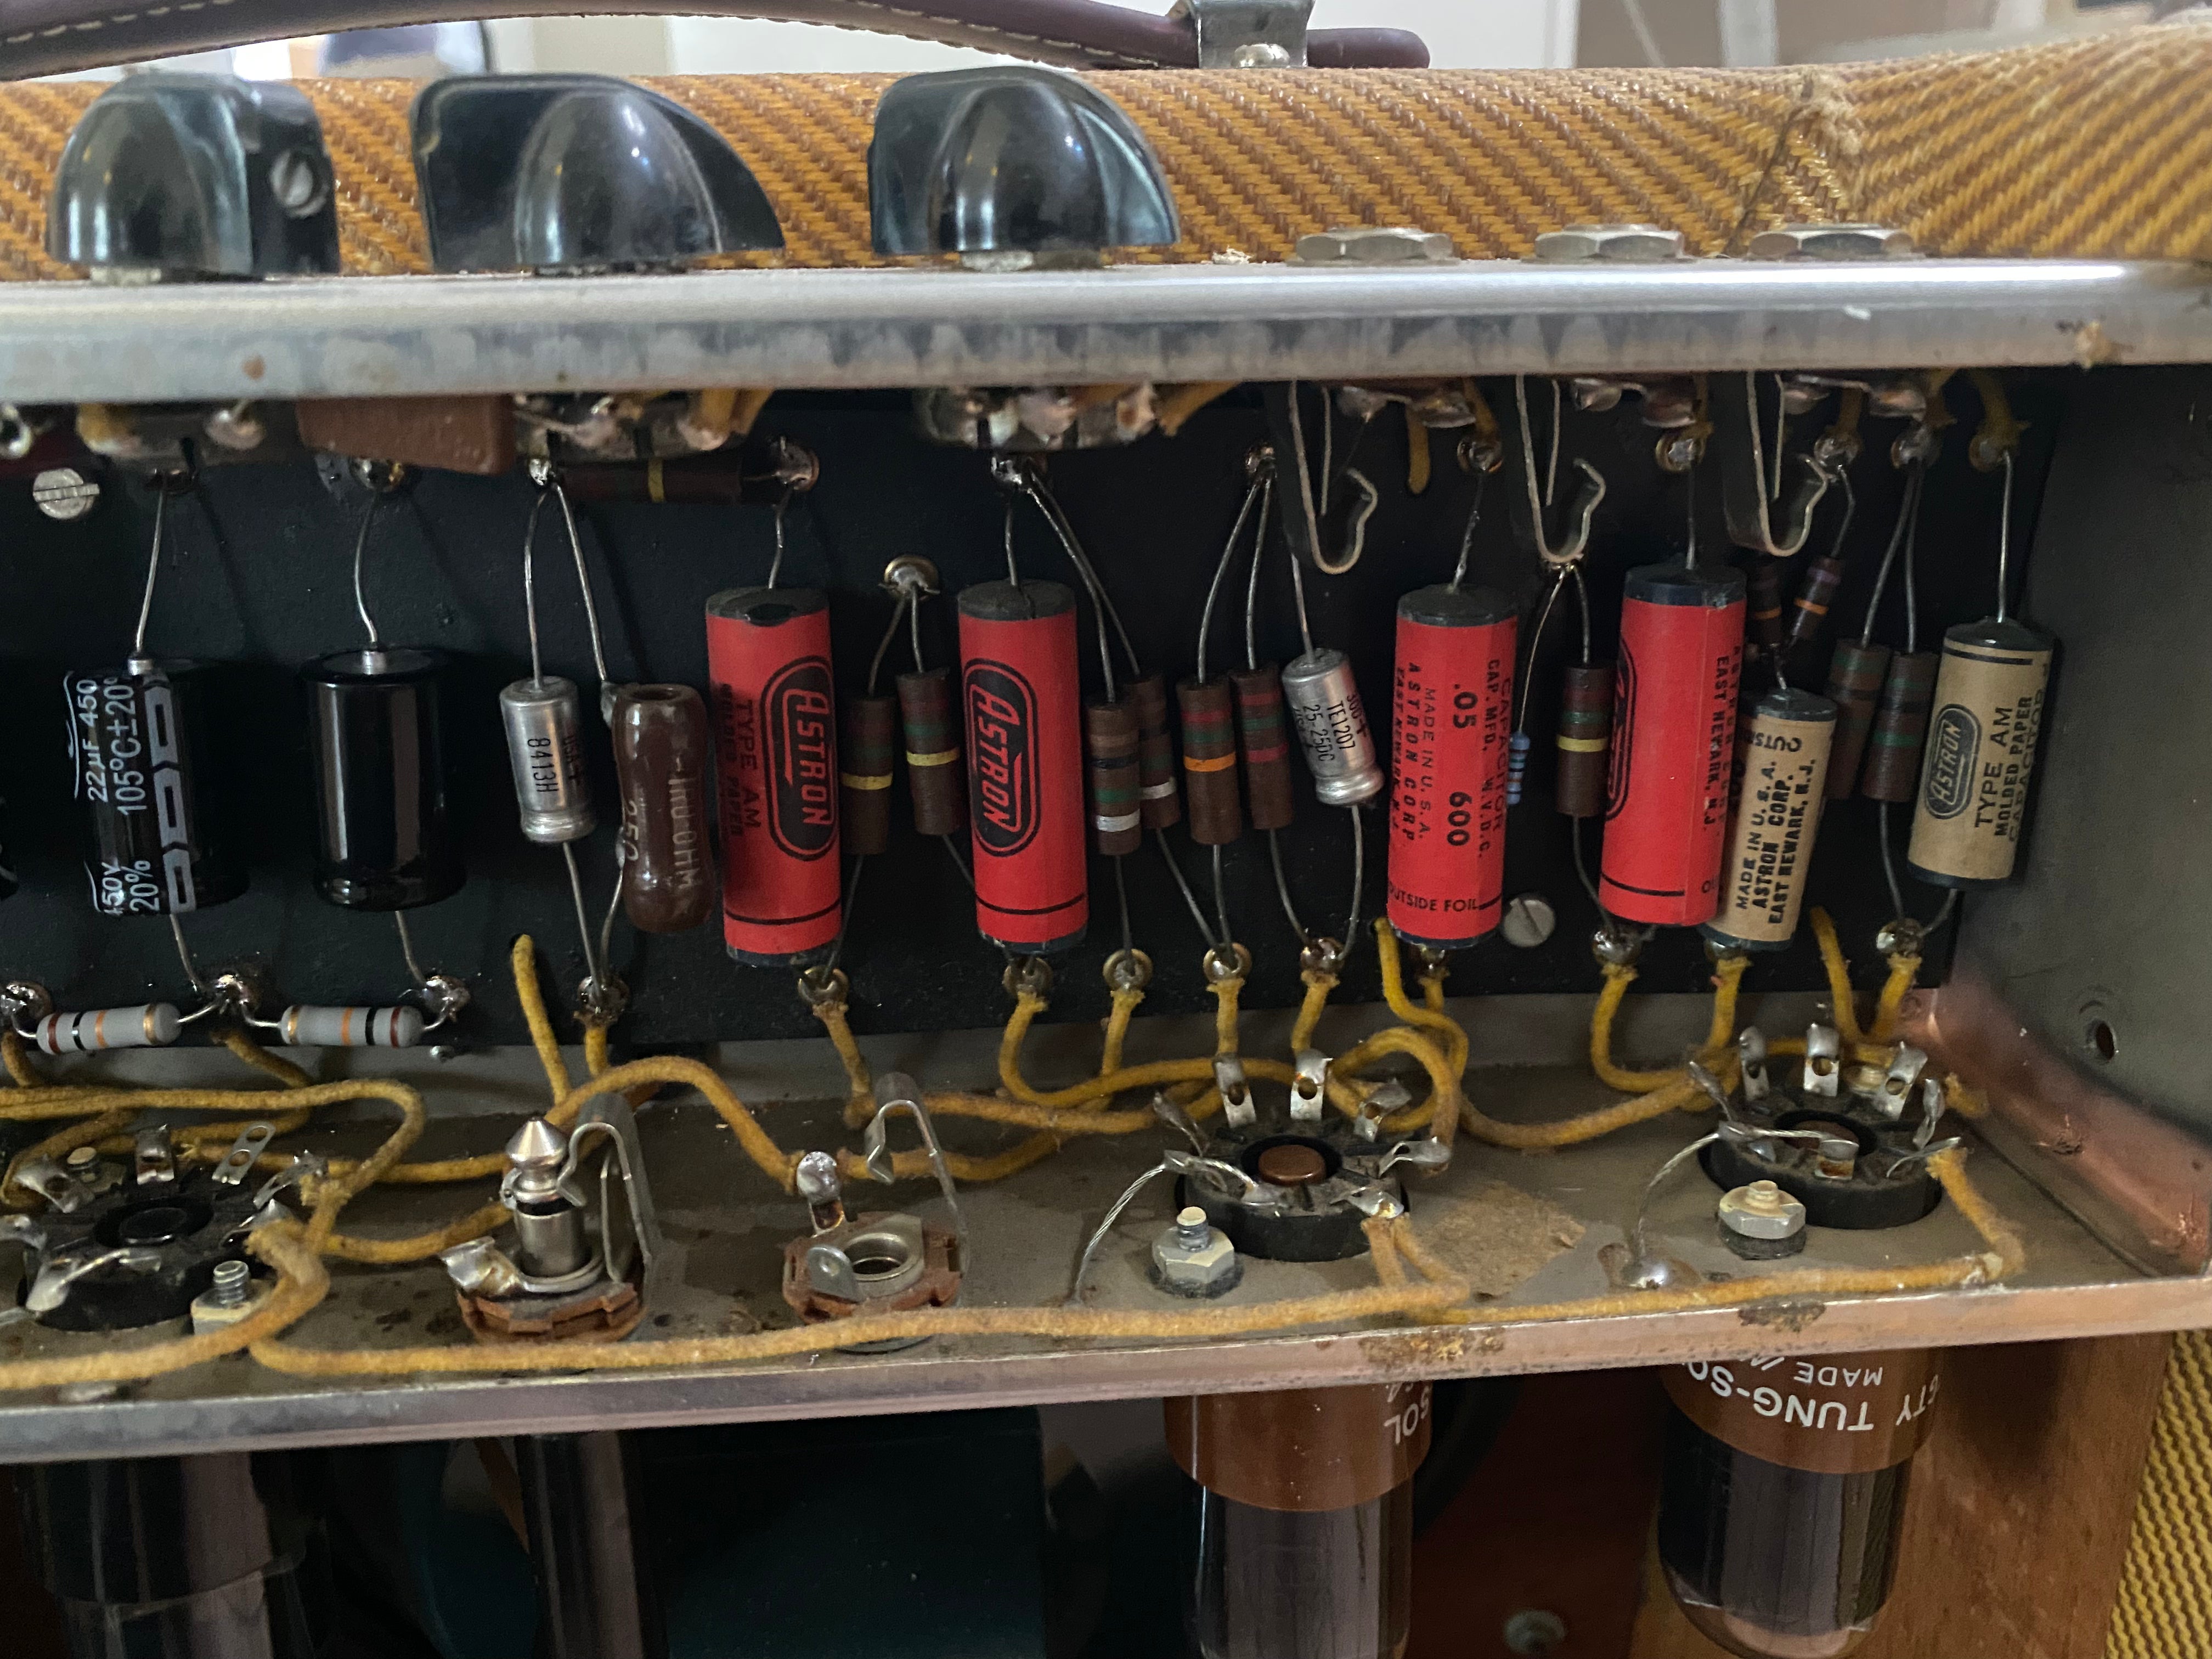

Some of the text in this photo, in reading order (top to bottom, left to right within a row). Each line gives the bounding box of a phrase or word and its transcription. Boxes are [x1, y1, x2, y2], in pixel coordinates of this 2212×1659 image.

[1714, 655, 1729, 700] EAST
[1302, 704, 1335, 761] 25-25DC
[1327, 700, 1356, 750] TE1207
[1406, 662, 1421, 763] ASTRON
[1423, 687, 1436, 742] MADE
[1746, 732, 1802, 752] OUTS
[527, 737, 560, 792] 8413H
[737, 699, 761, 828] TYPE AM
[783, 689, 833, 826] ASTRON
[969, 684, 1022, 832] ASTRON
[1421, 749, 1434, 768] IN
[1447, 684, 1478, 847] .05 600
[1931, 719, 1966, 805] ASTRON
[1974, 707, 2013, 828] TYPE AM
[1994, 696, 2032, 836] MOLDED PAPER
[1735, 857, 1757, 910] MADE
[1747, 831, 1762, 851] IN
[1752, 775, 1794, 909] ASTRON CORP.
[121, 860, 160, 911] 20%
[1444, 898, 1478, 913] FOIL
[1768, 881, 1790, 924] EAST
[1682, 1359, 1875, 1431] TUNG-SO
[1793, 1361, 1883, 1387] MADE
